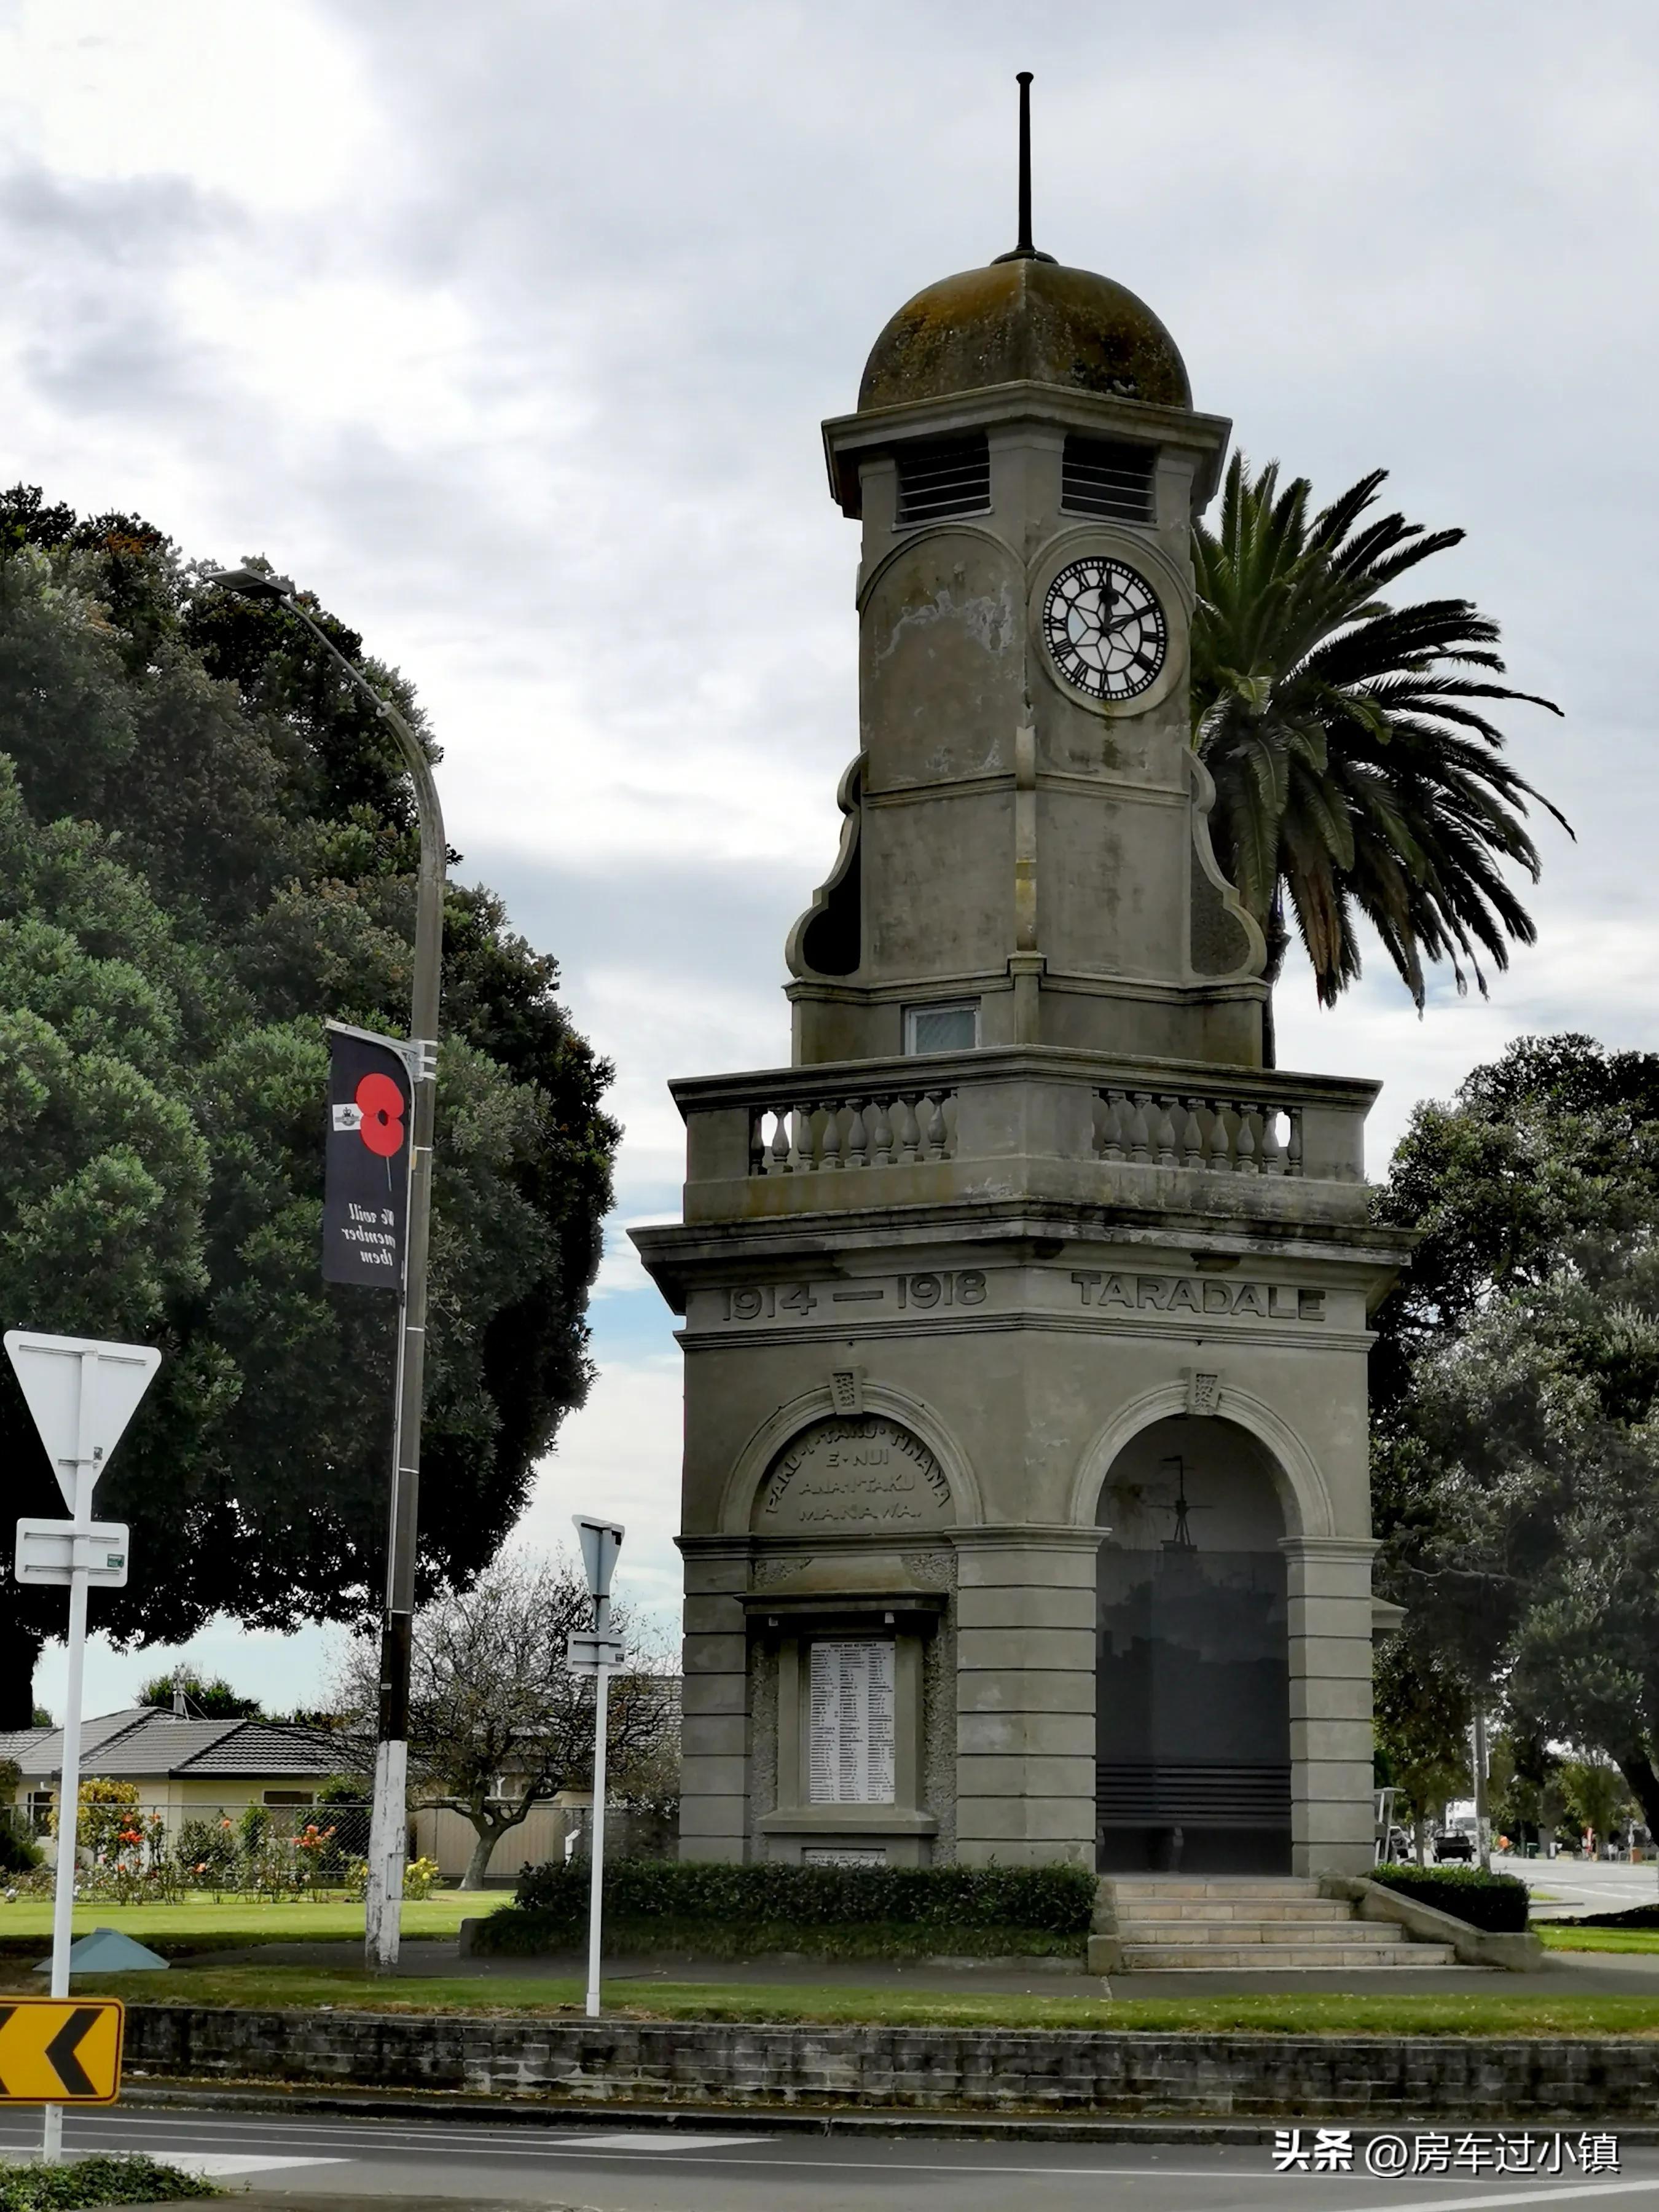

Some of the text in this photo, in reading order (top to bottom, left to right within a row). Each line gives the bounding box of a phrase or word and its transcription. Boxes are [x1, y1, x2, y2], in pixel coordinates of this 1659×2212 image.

[722, 1282, 818, 1322] 1914
[897, 1271, 987, 1309] 1918
[1071, 1271, 1327, 1321] TARADALE
